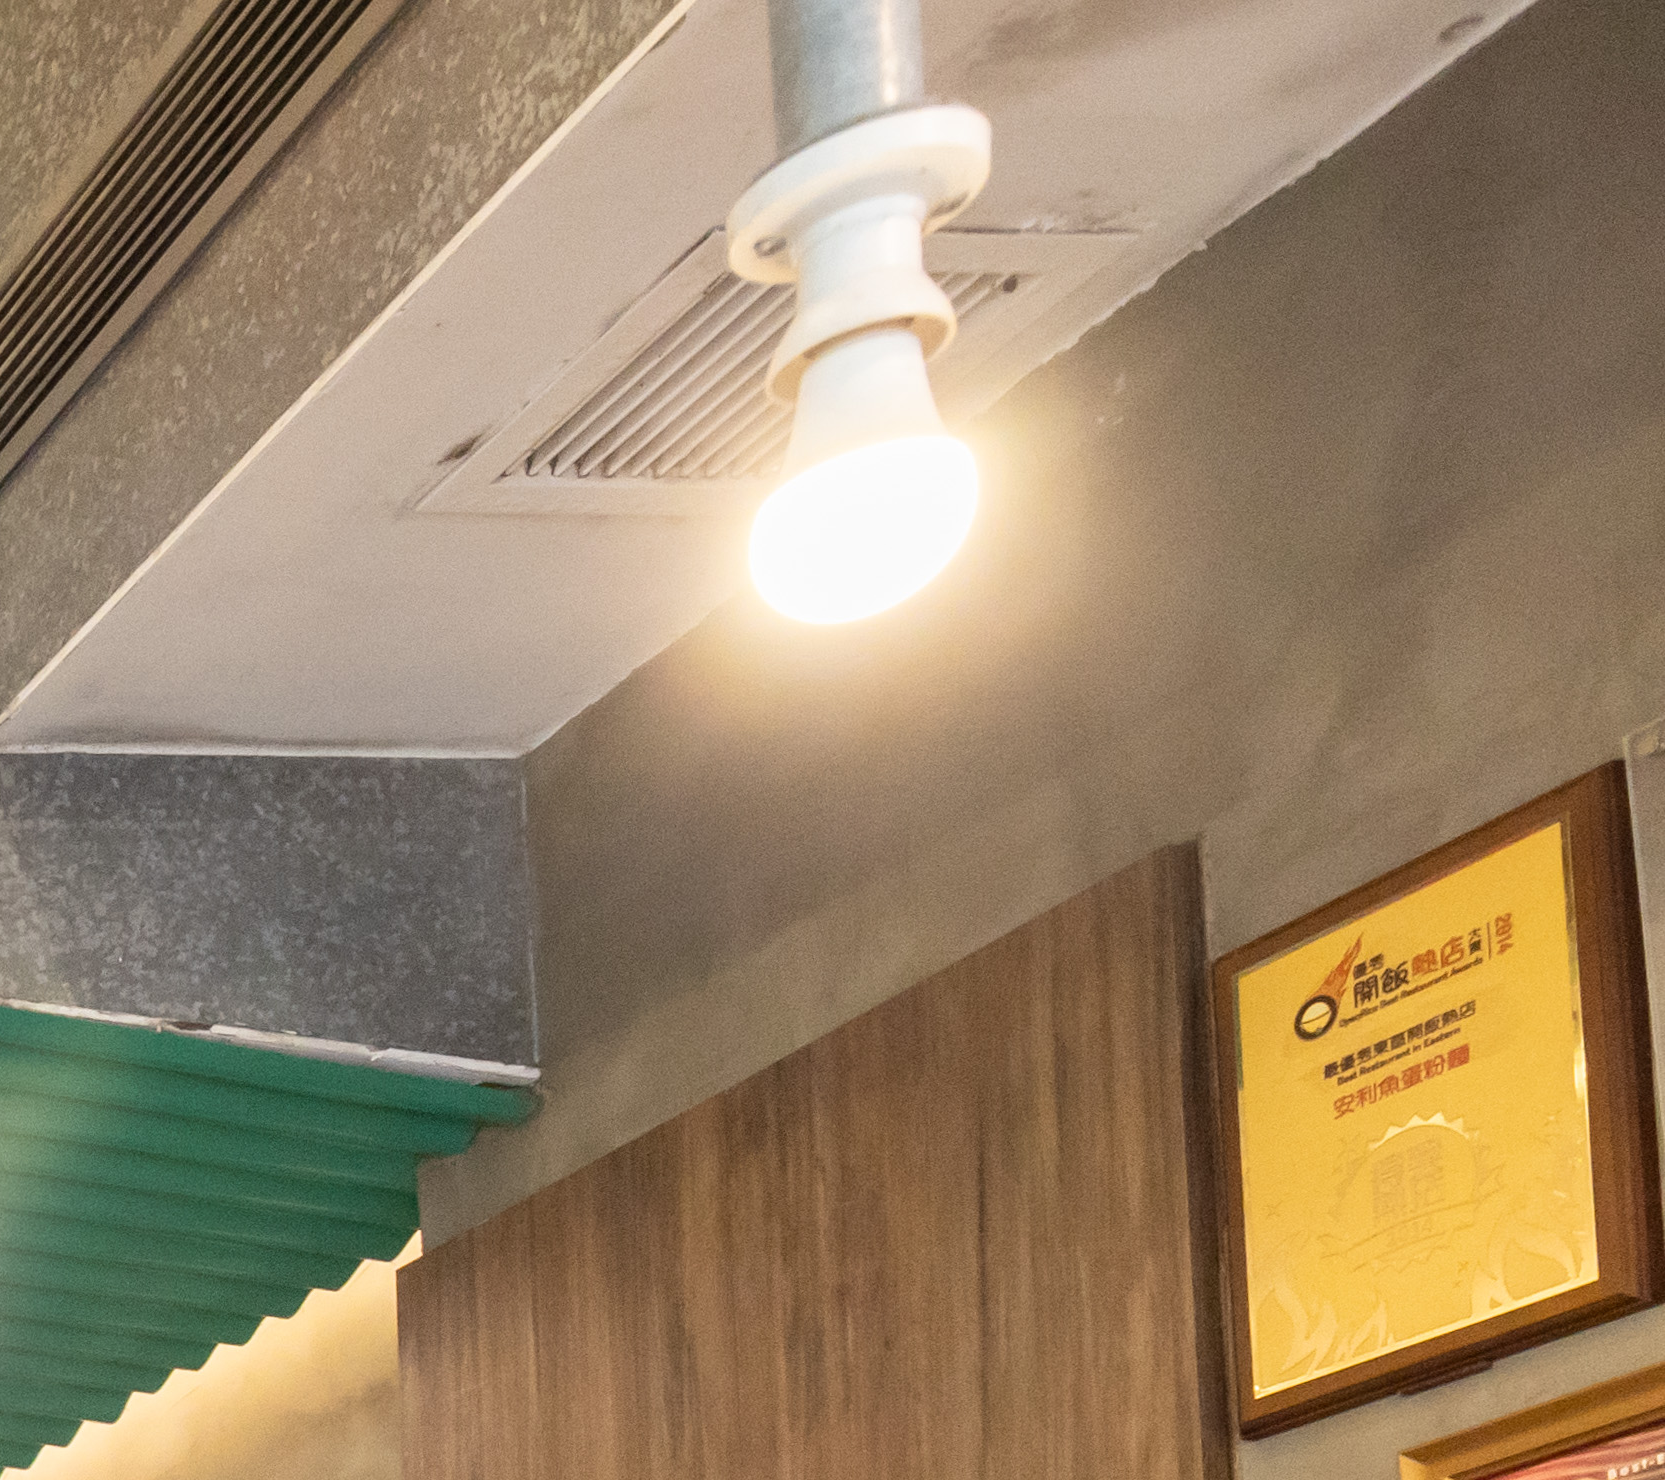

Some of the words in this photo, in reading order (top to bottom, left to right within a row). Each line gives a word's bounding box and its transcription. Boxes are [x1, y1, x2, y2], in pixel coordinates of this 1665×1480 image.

[1400, 975, 1448, 999] Restaurant
[1450, 957, 1483, 975] Awards
[1337, 1072, 1357, 1086] Best
[1359, 1049, 1410, 1076] Restaurant
[1424, 1027, 1461, 1048] Eastern
